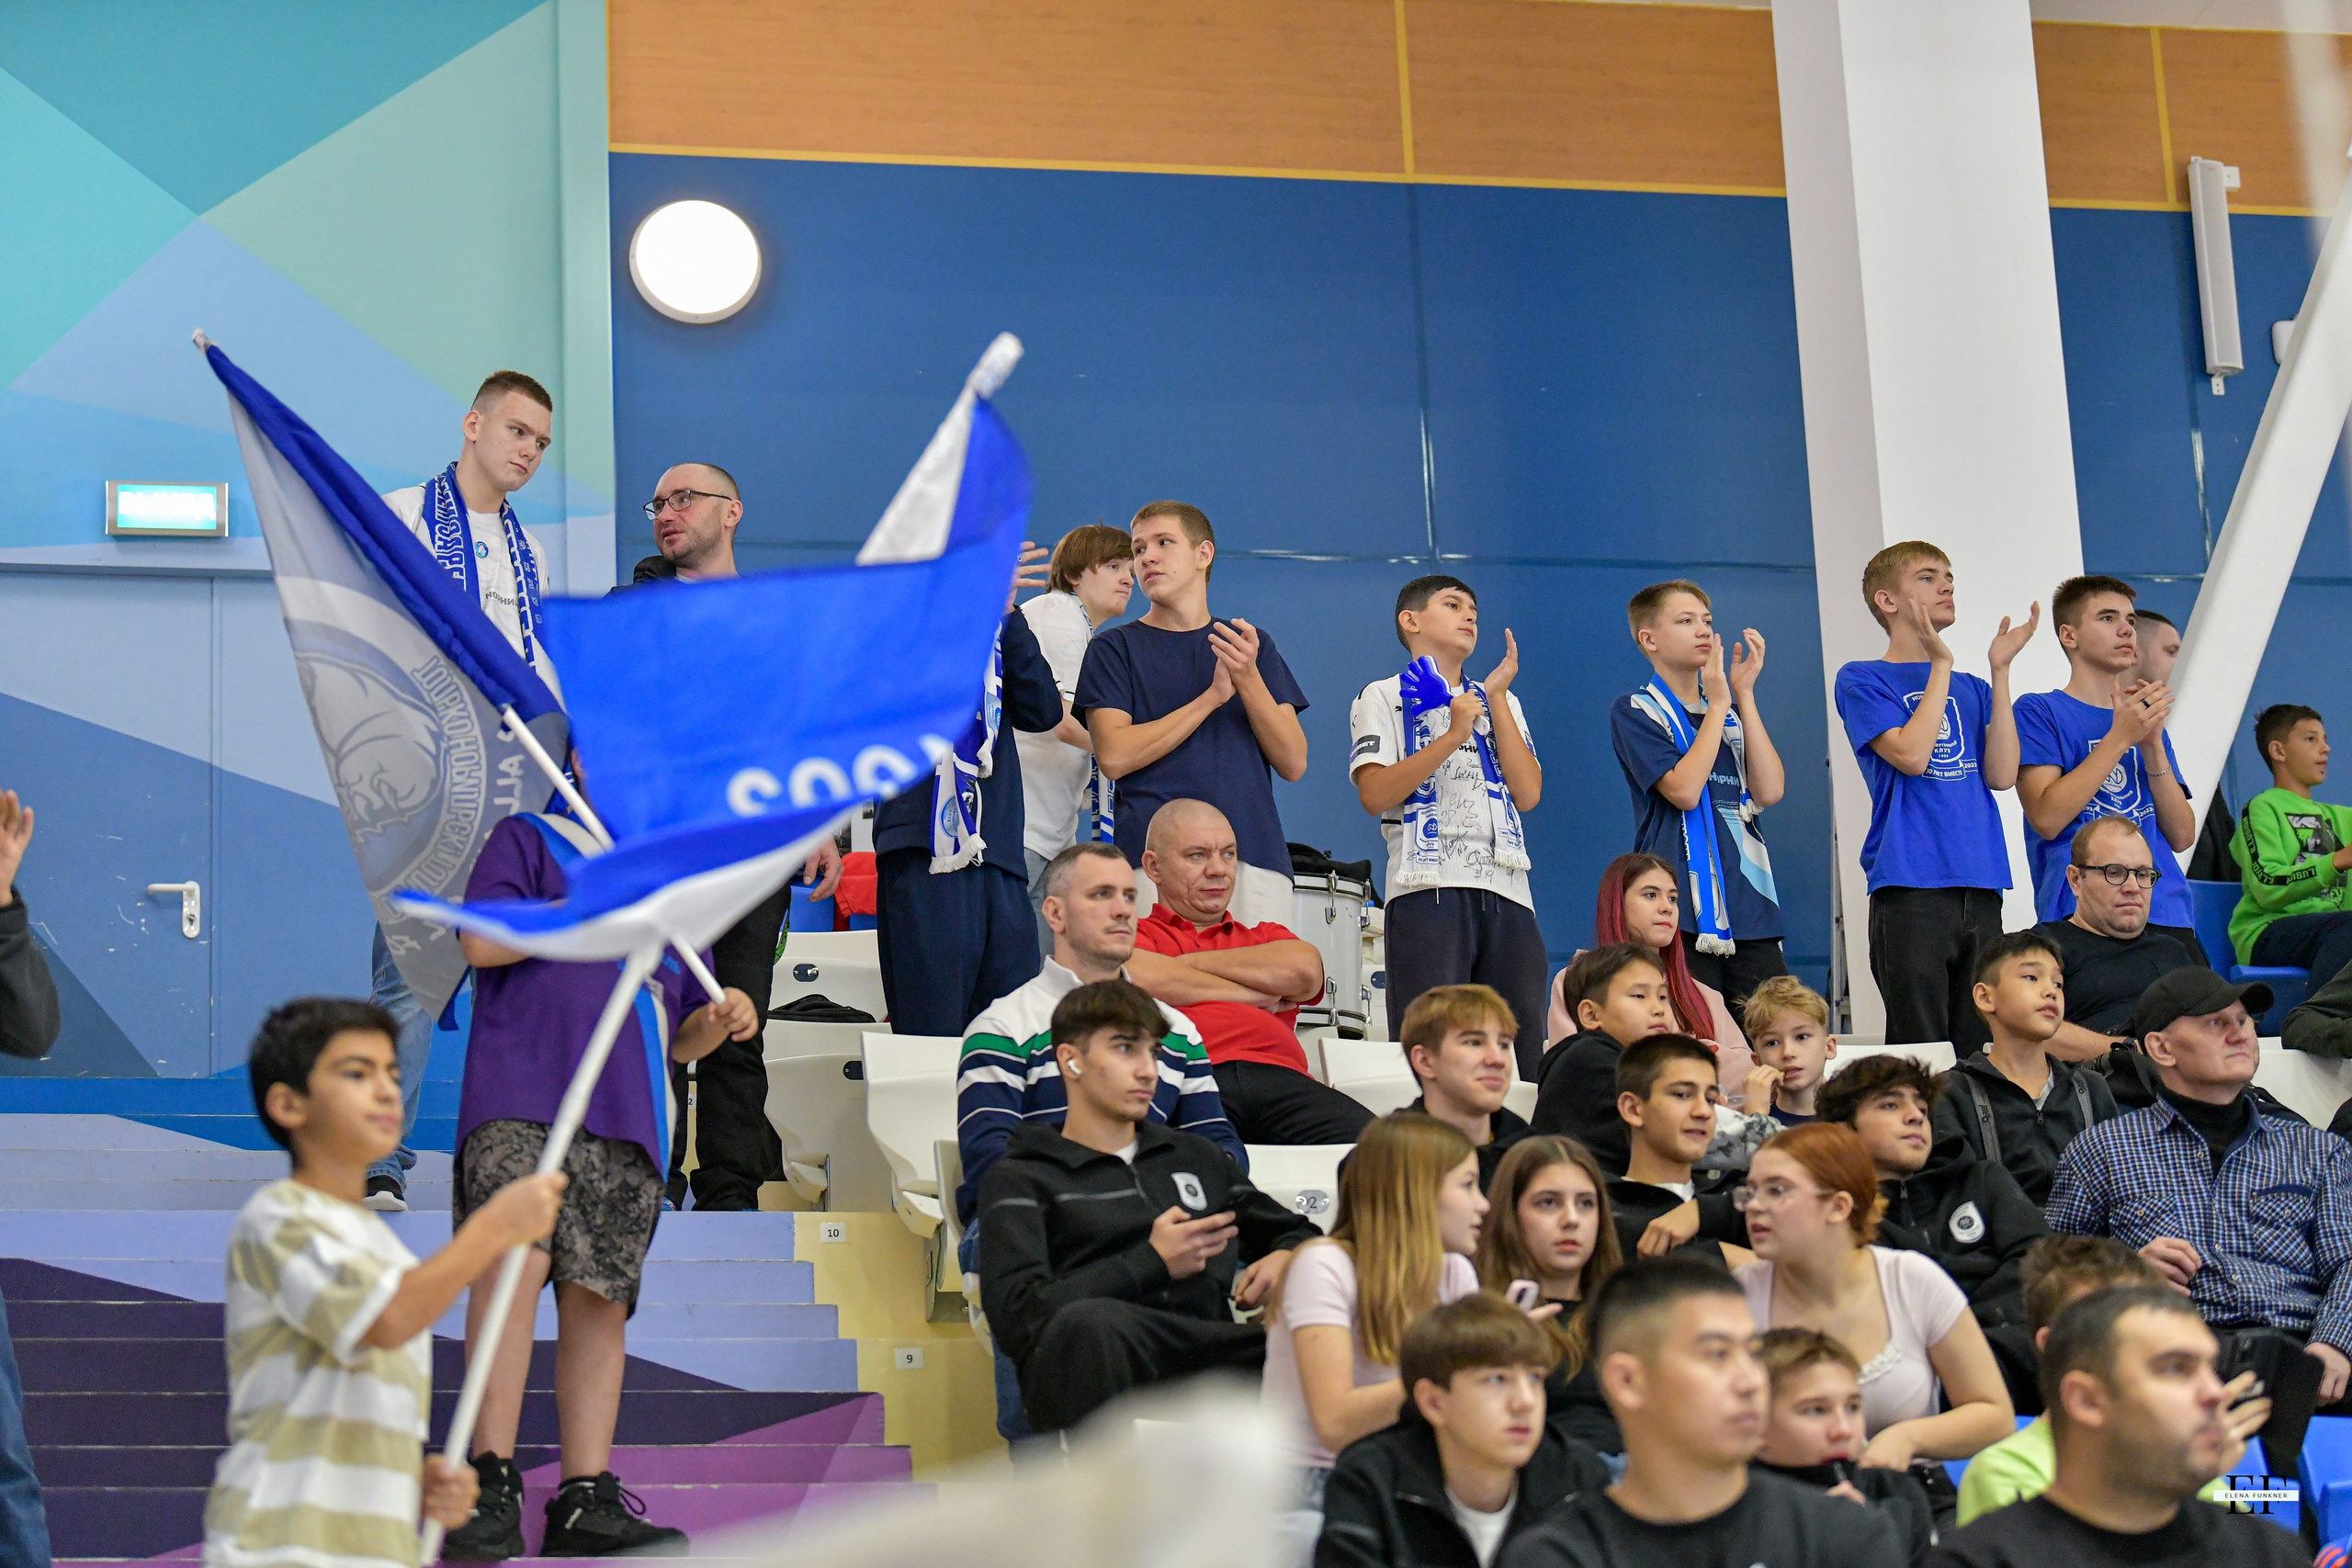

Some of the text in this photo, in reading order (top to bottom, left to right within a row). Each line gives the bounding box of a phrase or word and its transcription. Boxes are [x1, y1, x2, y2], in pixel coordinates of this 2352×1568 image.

[1308, 1196, 1317, 1209] 2
[827, 1228, 840, 1237] 10
[906, 1354, 913, 1364] 9
